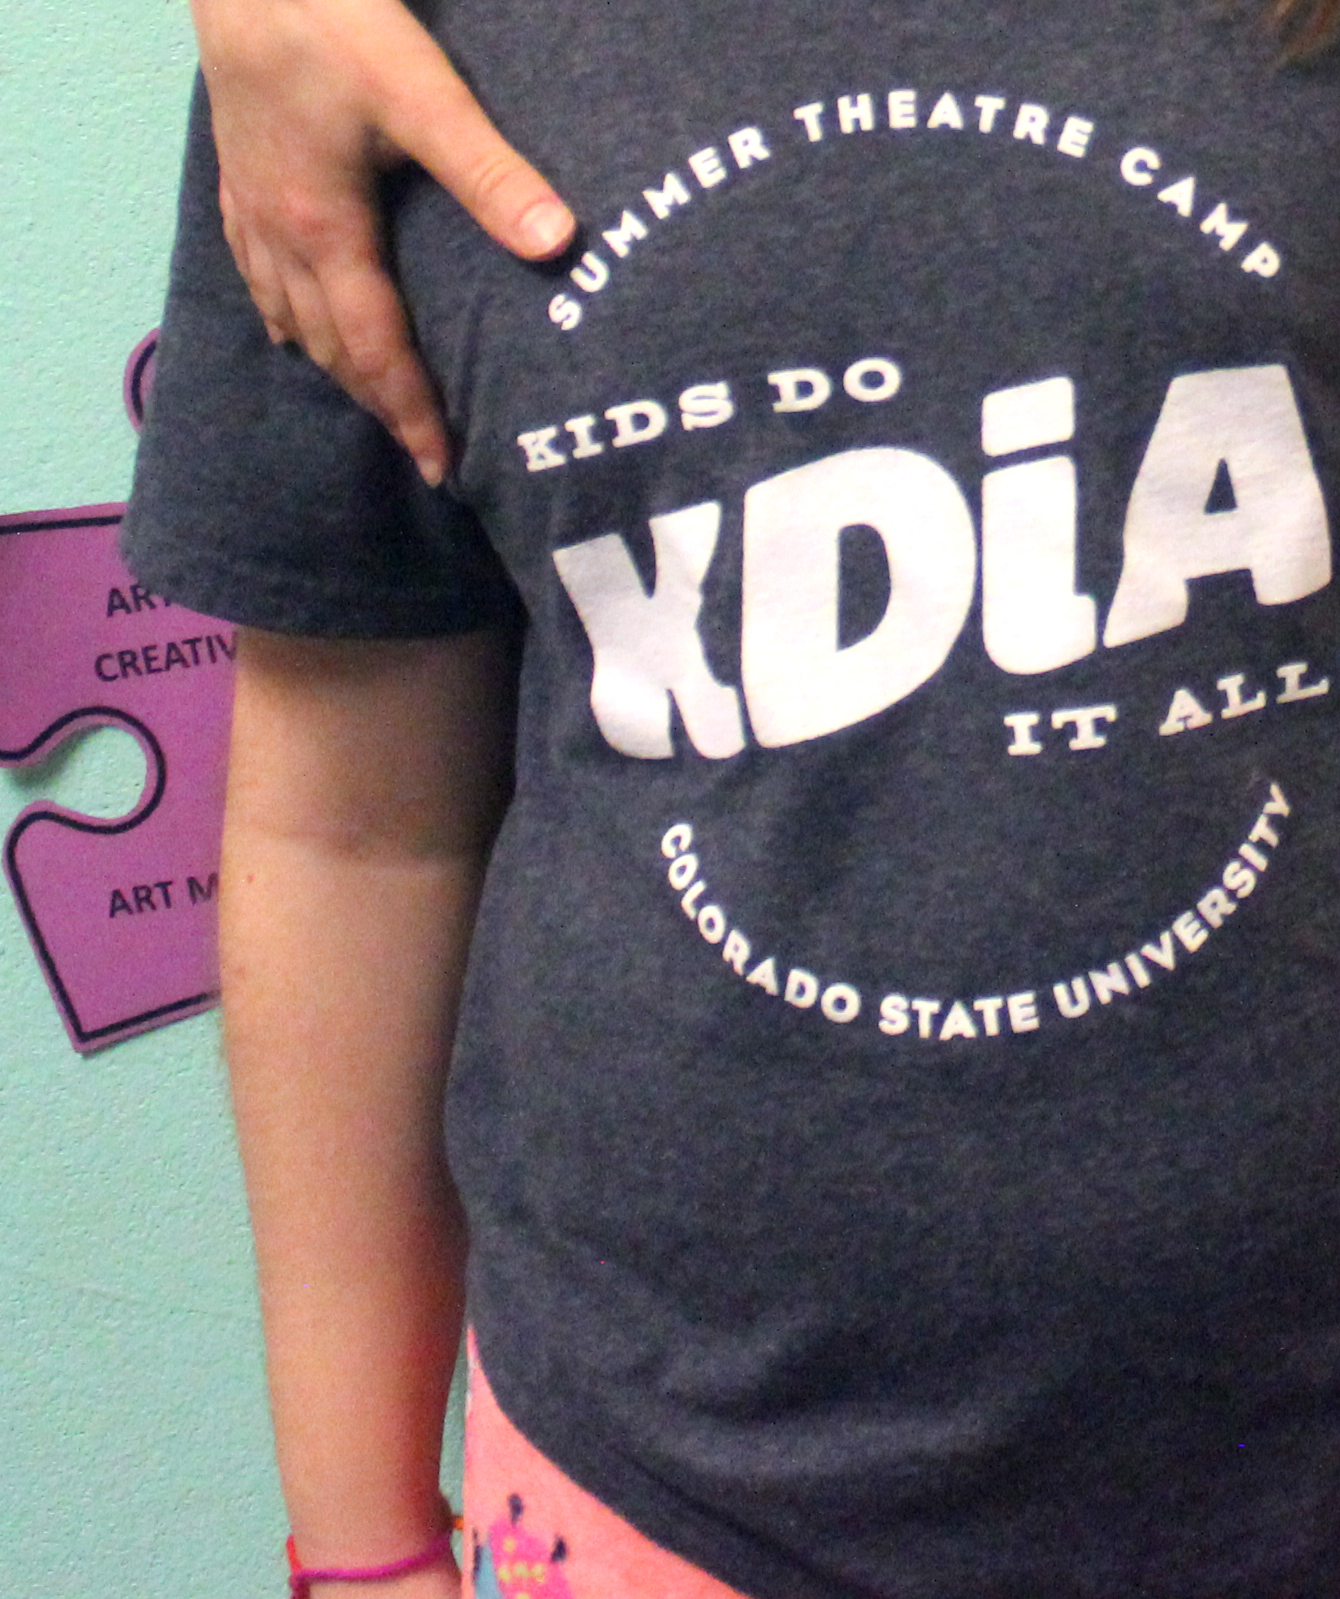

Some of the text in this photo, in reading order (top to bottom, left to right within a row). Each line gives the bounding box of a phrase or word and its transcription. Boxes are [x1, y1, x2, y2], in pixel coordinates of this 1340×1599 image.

[547, 89, 1281, 331] SUMMER THEATRE CAMP
[516, 357, 902, 474] KIDS DO
[106, 584, 172, 618] AR
[1003, 705, 1118, 756] IT
[109, 880, 174, 919] ART
[660, 782, 1292, 1041] COLORADO STATE UNIVERSITY
